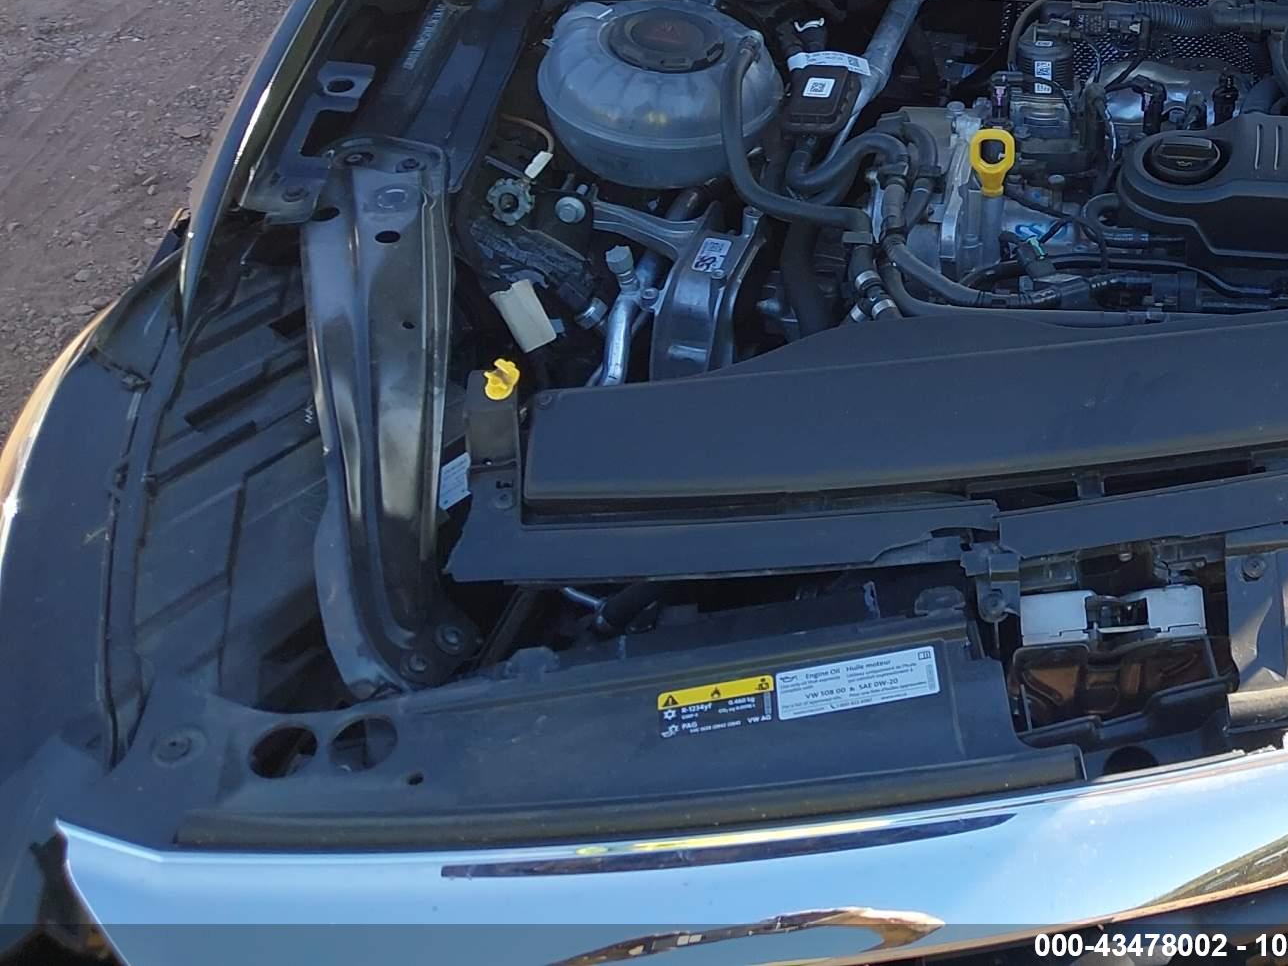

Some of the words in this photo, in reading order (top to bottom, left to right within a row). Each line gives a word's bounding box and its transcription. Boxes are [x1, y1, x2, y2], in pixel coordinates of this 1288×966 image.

[805, 670, 829, 680] Engine
[830, 667, 841, 675] Oil
[805, 691, 820, 700] VW
[858, 682, 873, 690] SAE
[873, 678, 899, 688] 0W-20
[681, 703, 713, 714] R-1234yf
[746, 716, 760, 724] VW
[760, 714, 772, 722] AG
[681, 722, 698, 730] PAG
